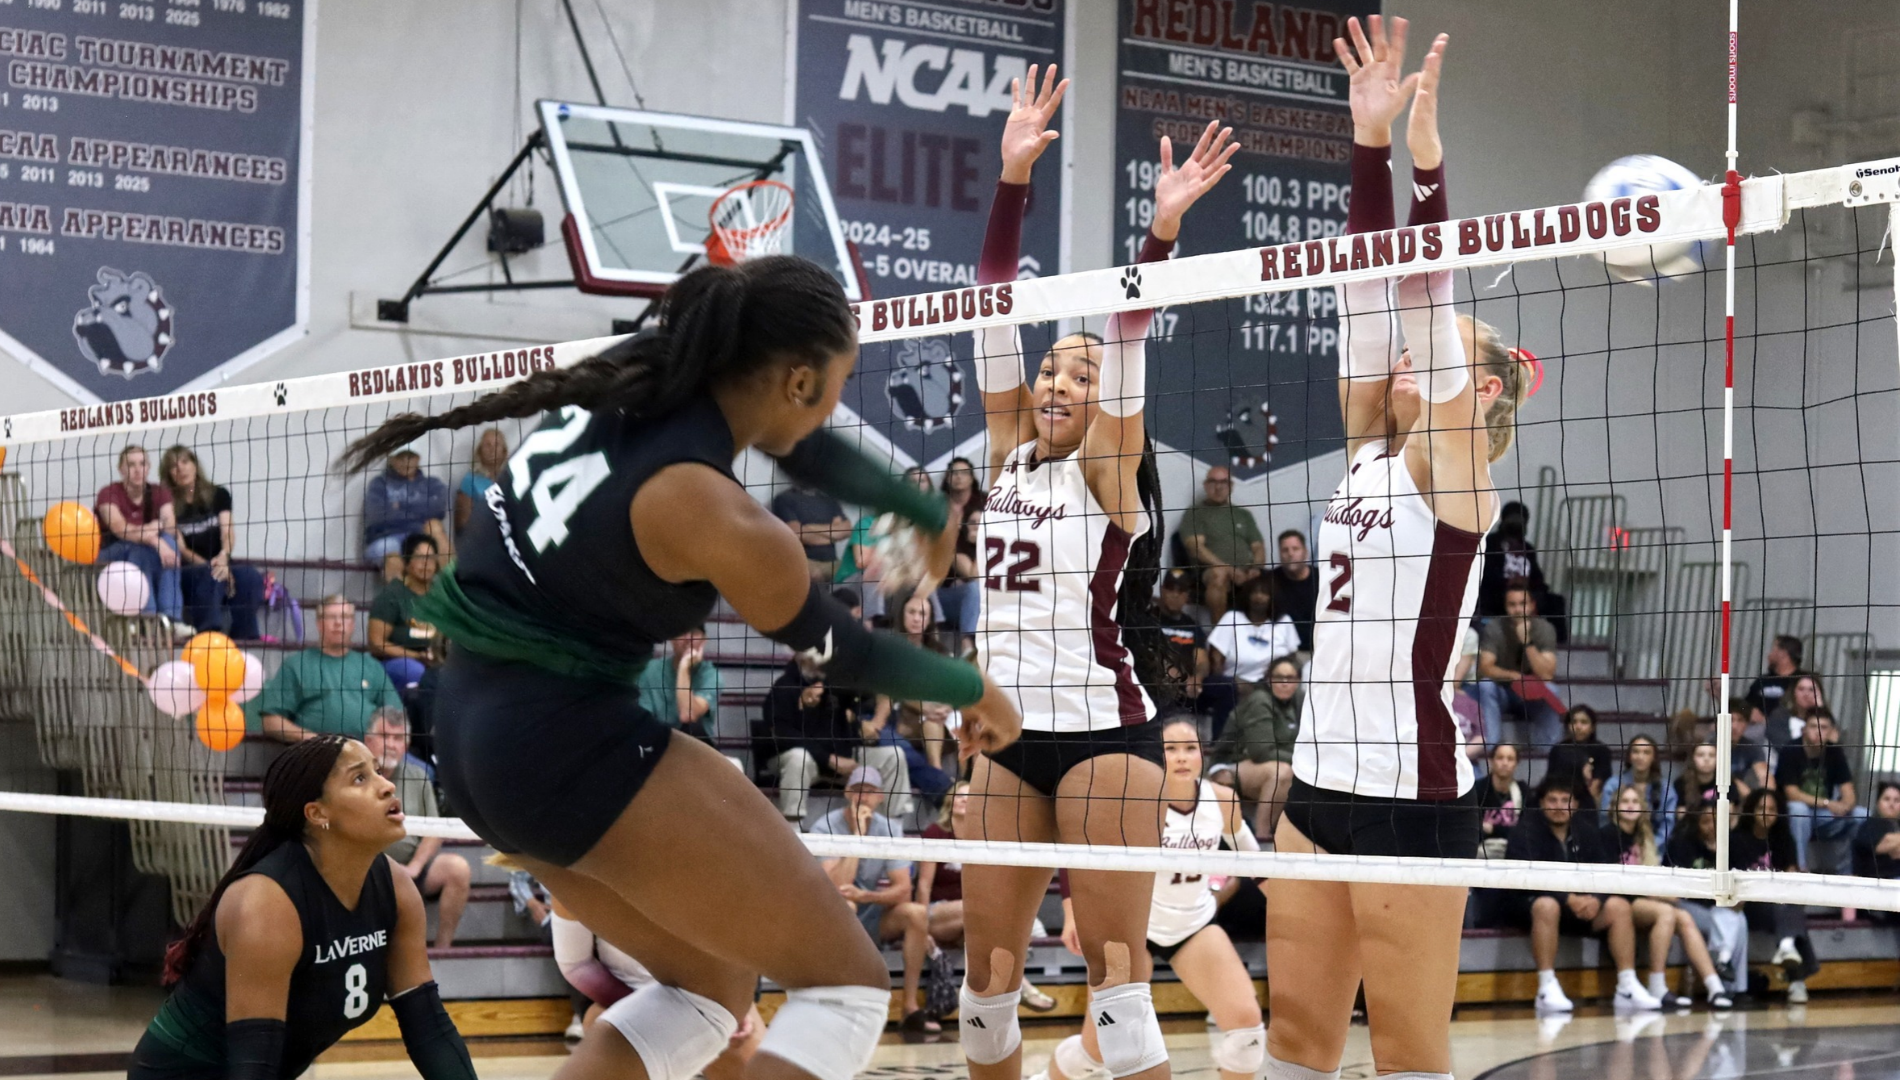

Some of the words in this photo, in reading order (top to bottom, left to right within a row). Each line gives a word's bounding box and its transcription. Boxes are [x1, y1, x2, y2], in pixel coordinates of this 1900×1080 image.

[73, 0, 106, 15] 2011
[119, 3, 154, 21] 2013
[165, 8, 200, 27] 2025
[844, 0, 902, 24] MEN'S
[905, 8, 1023, 42] BASKETBALL
[1132, 0, 1364, 66] REDLAND
[75, 35, 289, 86] TOURNAMENT
[839, 34, 1028, 117] NCAA
[1169, 52, 1222, 80] MEN'S
[1226, 61, 1337, 95] BASKETBALL
[9, 59, 258, 113] CHAMPIONSHIPS
[23, 93, 58, 112] 2013
[1122, 86, 1182, 114] NCAA
[1185, 93, 1246, 122] MEN'S
[1251, 103, 1352, 138] BASKETBA
[68, 136, 287, 185] APPEARANCES
[836, 122, 981, 213] ELITE
[1238, 129, 1352, 164] CHAMPIONS
[21, 165, 55, 183] 2011
[68, 170, 104, 188] 2013
[115, 174, 150, 193] 2025
[1242, 173, 1301, 209] 100.3
[61, 207, 286, 255] APPEARANCES
[1125, 197, 1156, 228] 19
[1242, 210, 1301, 244] 104.8
[1307, 216, 1347, 241] PP
[20, 237, 55, 256] 1964
[1259, 224, 1443, 281] REDLANDS
[1458, 194, 1661, 256] BULLDOGS
[893, 257, 977, 287] OVERAL
[872, 283, 1013, 332] BULLDOGS
[1307, 291, 1337, 319] PP
[1240, 320, 1298, 354] 117.1
[1307, 326, 1339, 357] PP
[349, 361, 443, 397] REDLANDS
[452, 346, 555, 385] BULLDOGS
[60, 405, 134, 432] REDLANDS
[140, 392, 217, 423] BULLDOGS
[507, 403, 612, 555] 24
[984, 536, 1042, 594] 22
[1325, 550, 1353, 615] 2
[343, 963, 369, 1020] 8
